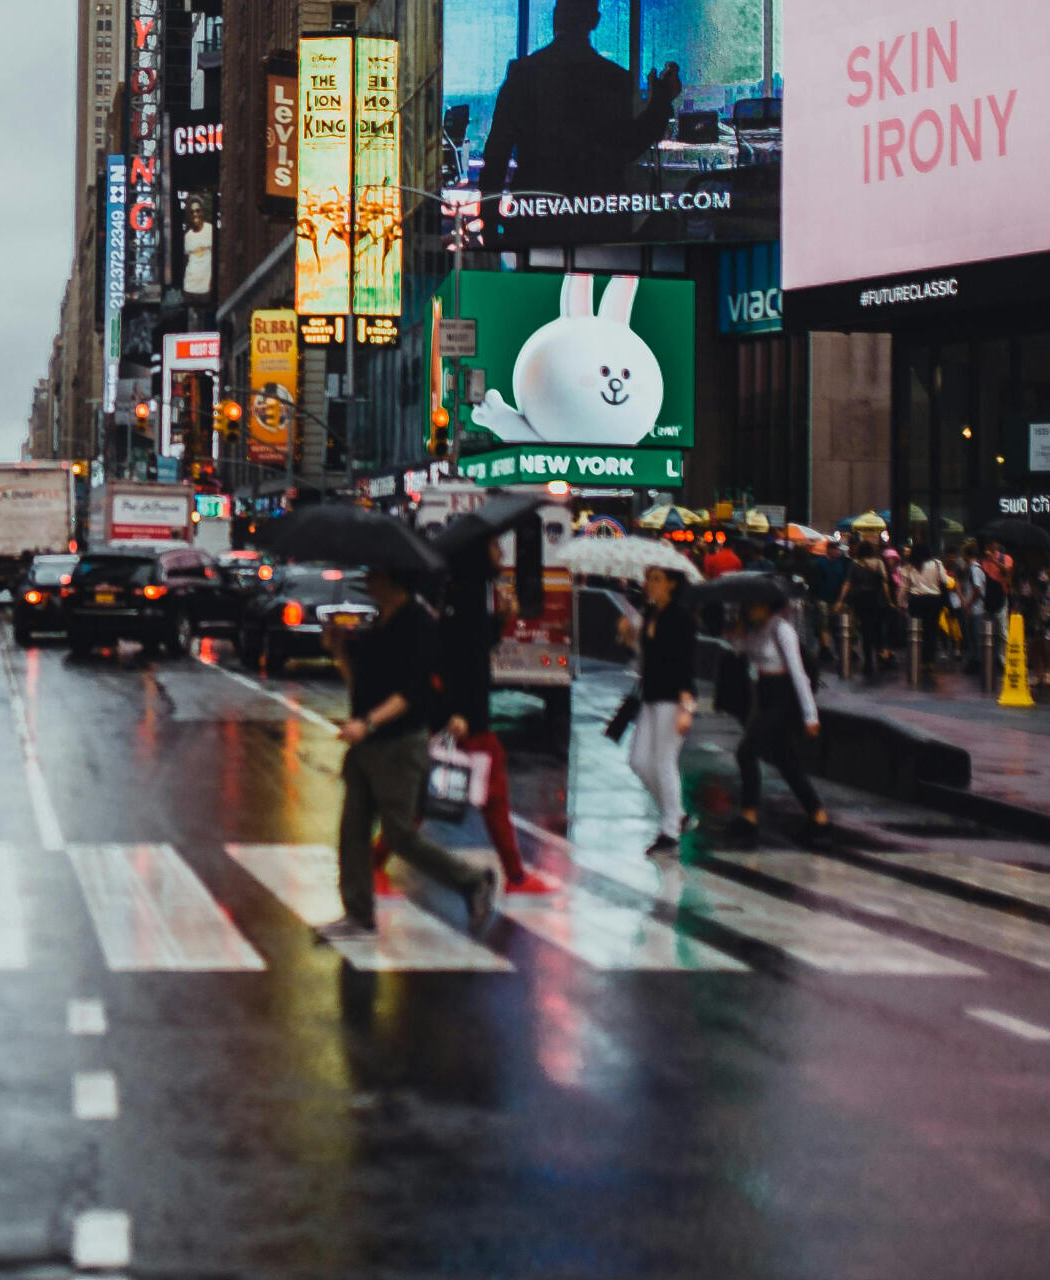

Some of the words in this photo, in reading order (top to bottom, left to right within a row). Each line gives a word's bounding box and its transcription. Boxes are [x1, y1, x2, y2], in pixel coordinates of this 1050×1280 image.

[846, 20, 959, 109] SKIN
[311, 75, 336, 87] THE
[306, 91, 341, 111] LION
[304, 114, 346, 139] KING
[862, 89, 1018, 185] IRONY
[500, 191, 732, 218] ONEVANDERBILT.COM
[859, 278, 958, 307] #FUTURECLASSIC
[254, 318, 296, 334] BUBBA
[257, 337, 293, 354] GUMP
[519, 455, 571, 475] NEW
[575, 456, 635, 476] YORK
